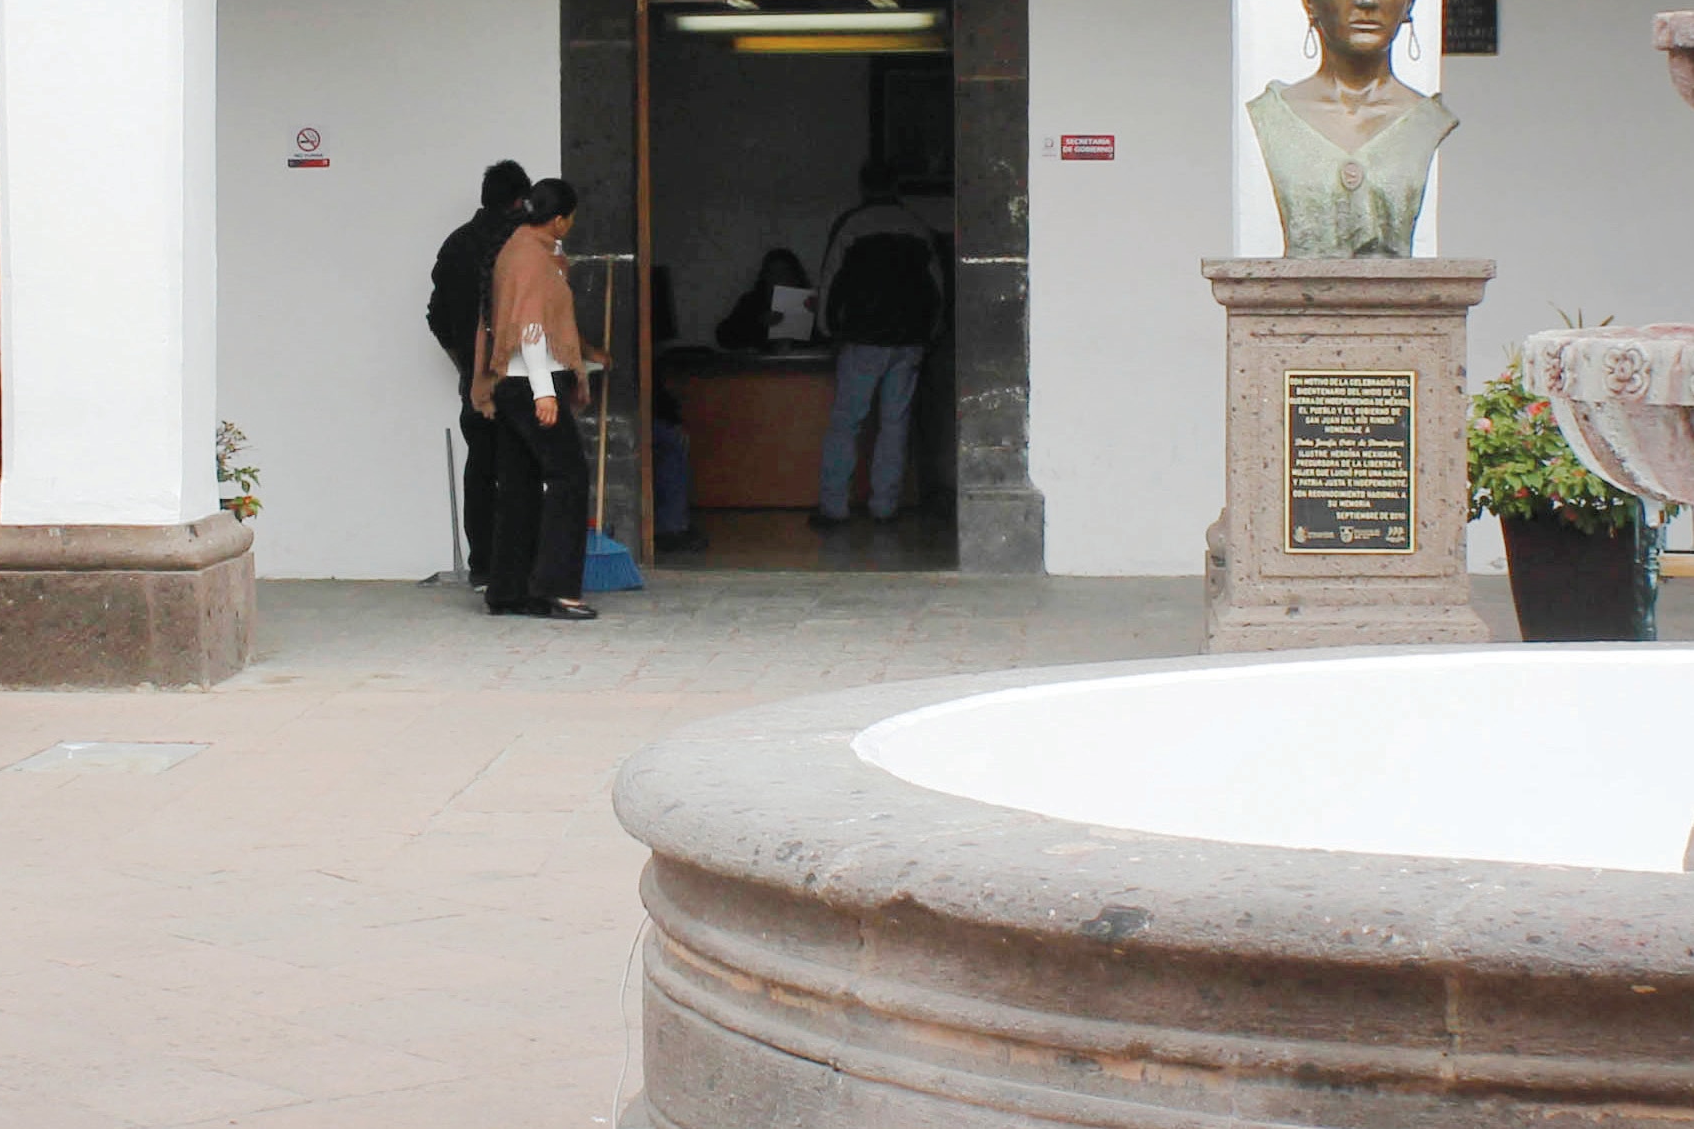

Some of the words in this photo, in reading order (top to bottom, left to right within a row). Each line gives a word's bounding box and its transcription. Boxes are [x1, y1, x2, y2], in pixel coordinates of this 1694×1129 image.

[1329, 377, 1338, 386] DE
[1339, 377, 1348, 386] LA
[1396, 377, 1409, 386] DEL
[1296, 387, 1346, 396] BICENTENARIO
[1347, 387, 1360, 396] DEL
[1383, 387, 1391, 396] DE
[1393, 387, 1402, 396] LA
[1298, 406, 1308, 415] EL
[1310, 406, 1336, 415] PUEBLO
[1344, 406, 1354, 415] EL
[1355, 406, 1389, 415] GOBIERNO
[1391, 406, 1400, 415] DE
[1306, 416, 1320, 424] SAN
[1321, 416, 1340, 424] JUAN
[1341, 416, 1354, 424] DEL
[1341, 459, 1350, 468] DE
[1352, 459, 1362, 468] LA
[1363, 459, 1396, 468] LIBERTAD
[1328, 499, 1337, 508] SU
[1379, 511, 1387, 520] DE
